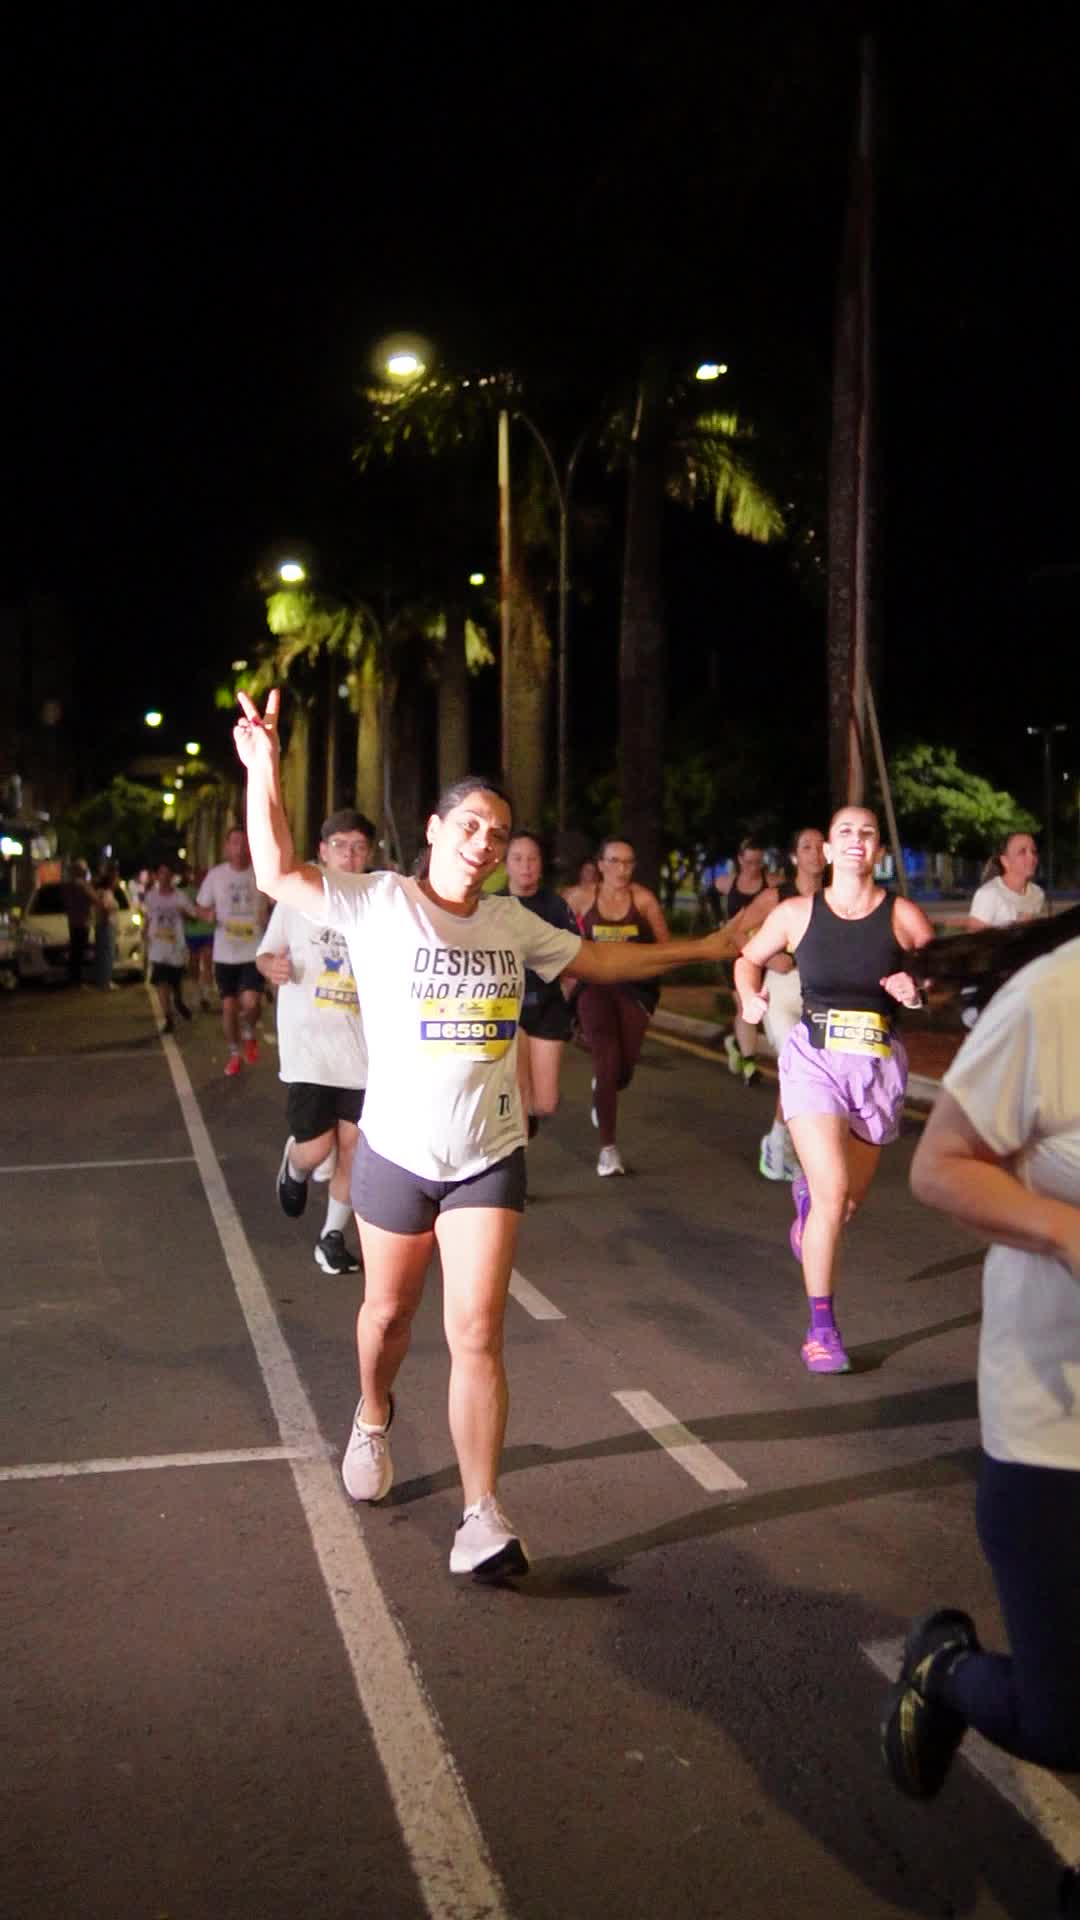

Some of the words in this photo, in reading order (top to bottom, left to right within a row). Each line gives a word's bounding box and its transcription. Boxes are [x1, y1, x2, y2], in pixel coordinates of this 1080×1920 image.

[413, 947, 518, 976] DESISTIR
[411, 976, 449, 999] NÃO
[442, 1023, 498, 1039] 6590
